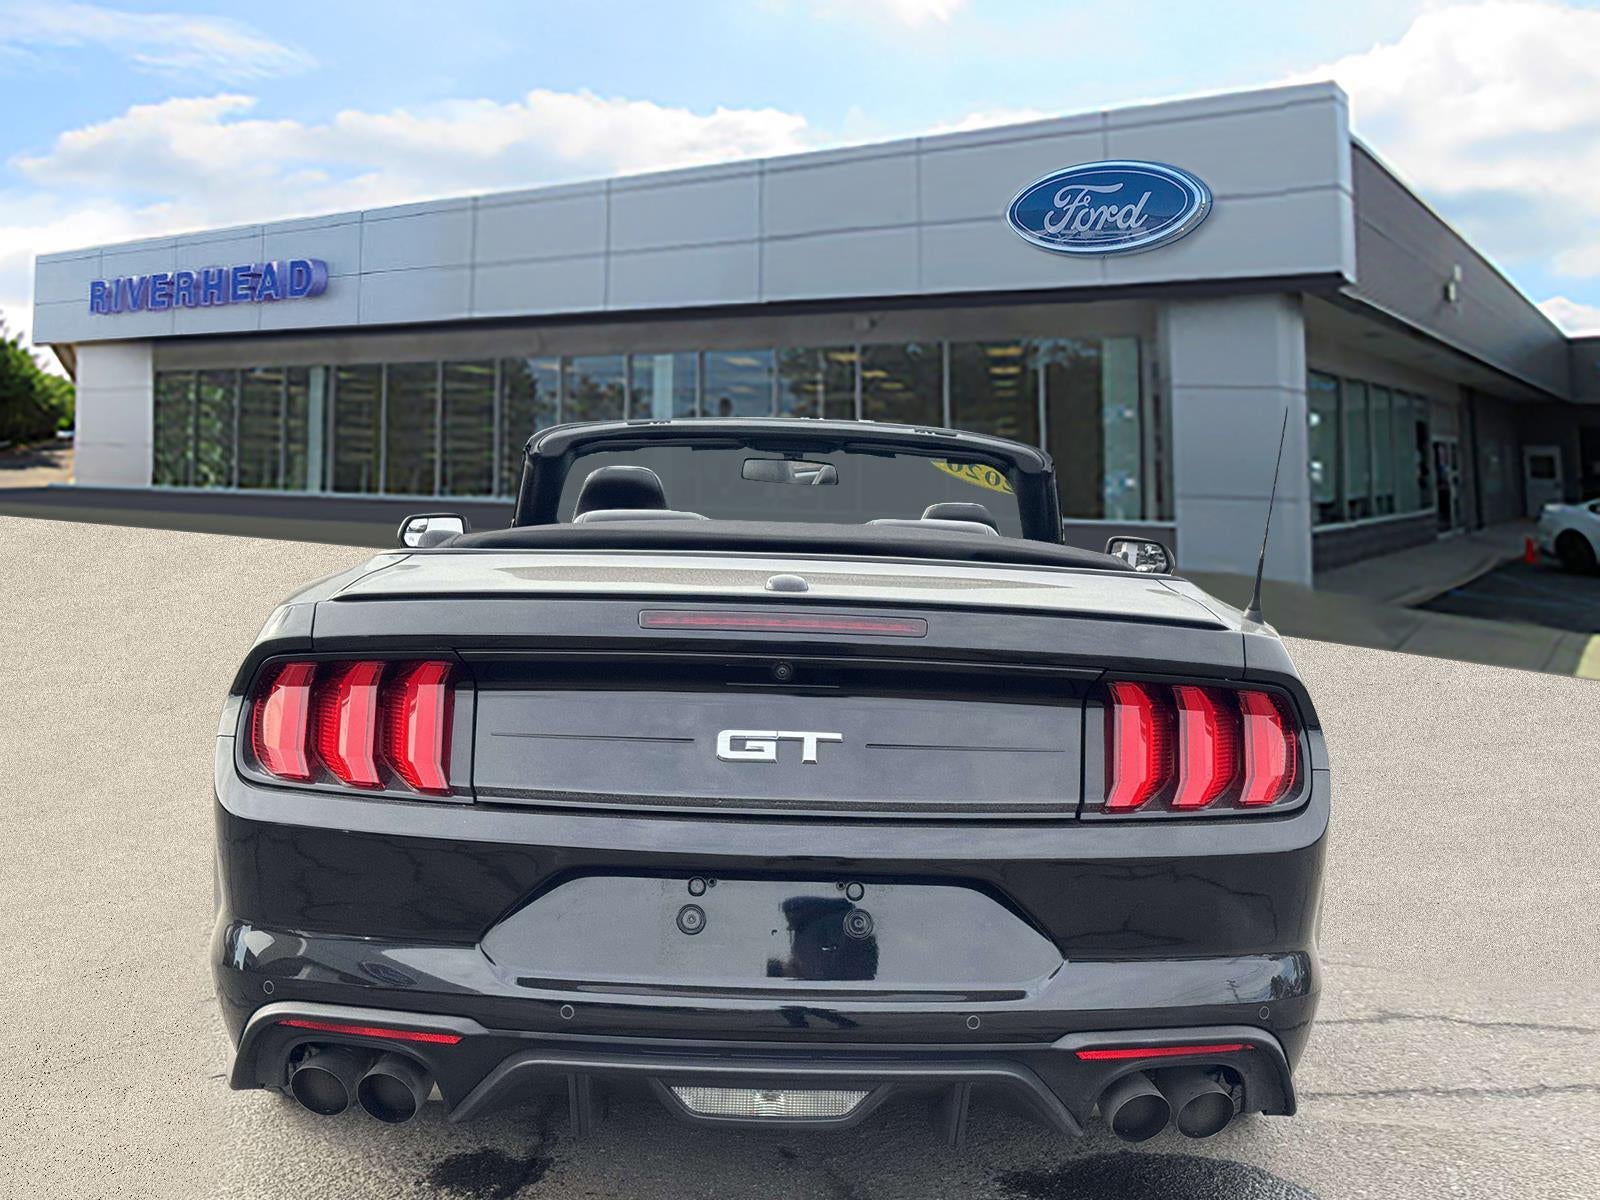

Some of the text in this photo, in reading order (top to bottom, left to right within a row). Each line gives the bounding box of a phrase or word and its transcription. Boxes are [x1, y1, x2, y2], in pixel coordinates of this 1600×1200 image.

[1043, 182, 1152, 234] Ford
[89, 258, 325, 314] RIVERHEAD
[717, 729, 844, 764] GT
